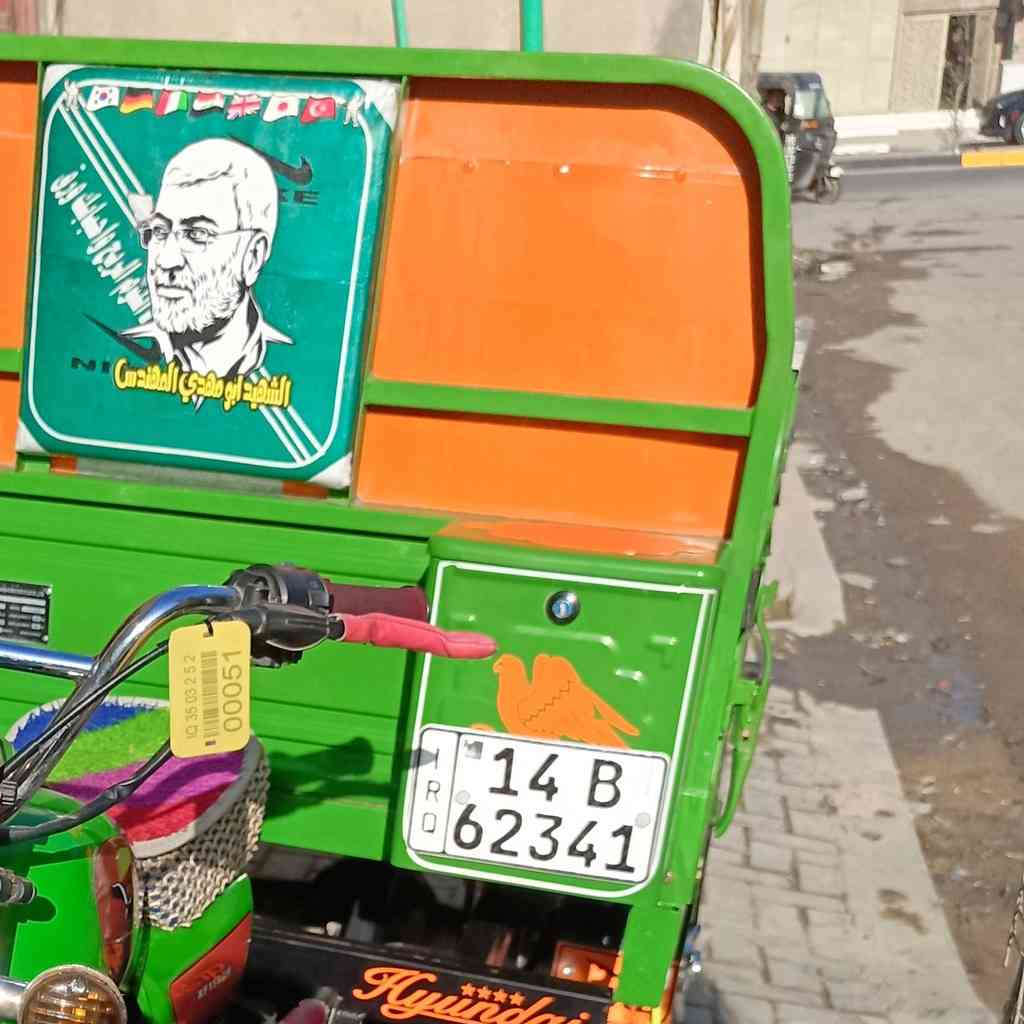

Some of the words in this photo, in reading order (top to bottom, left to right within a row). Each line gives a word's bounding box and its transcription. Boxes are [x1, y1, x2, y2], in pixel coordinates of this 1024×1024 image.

[114, 358, 180, 394] المهندس
[242, 375, 292, 409] الشهيد
[222, 649, 243, 733] 00051
[489, 747, 559, 802] 14
[587, 758, 623, 809] B
[453, 803, 636, 874] 62341
